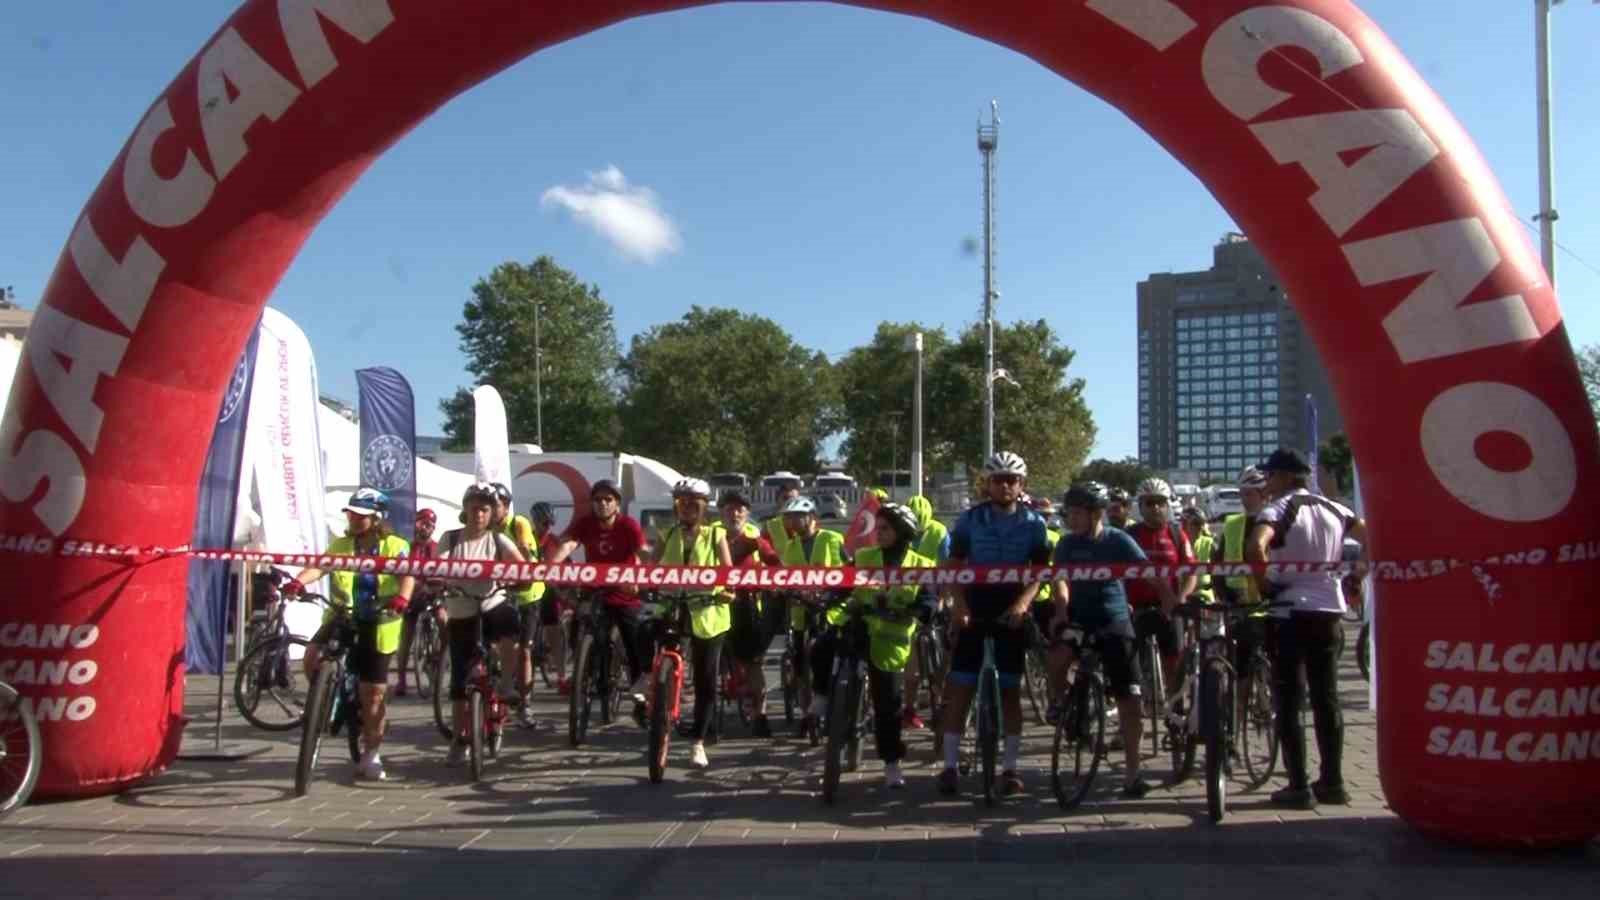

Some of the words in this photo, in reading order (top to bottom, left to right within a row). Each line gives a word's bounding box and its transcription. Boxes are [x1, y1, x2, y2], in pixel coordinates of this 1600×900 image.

[1084, 0, 1578, 522] CANO
[283, 554, 377, 572] SALCANO
[384, 559, 481, 578] SALCANO
[491, 563, 597, 582] SALCANO
[605, 566, 718, 585] SALCANO
[727, 568, 844, 586] SALCANO
[854, 568, 976, 586] SALCANO
[986, 567, 1112, 585] SALCANO
